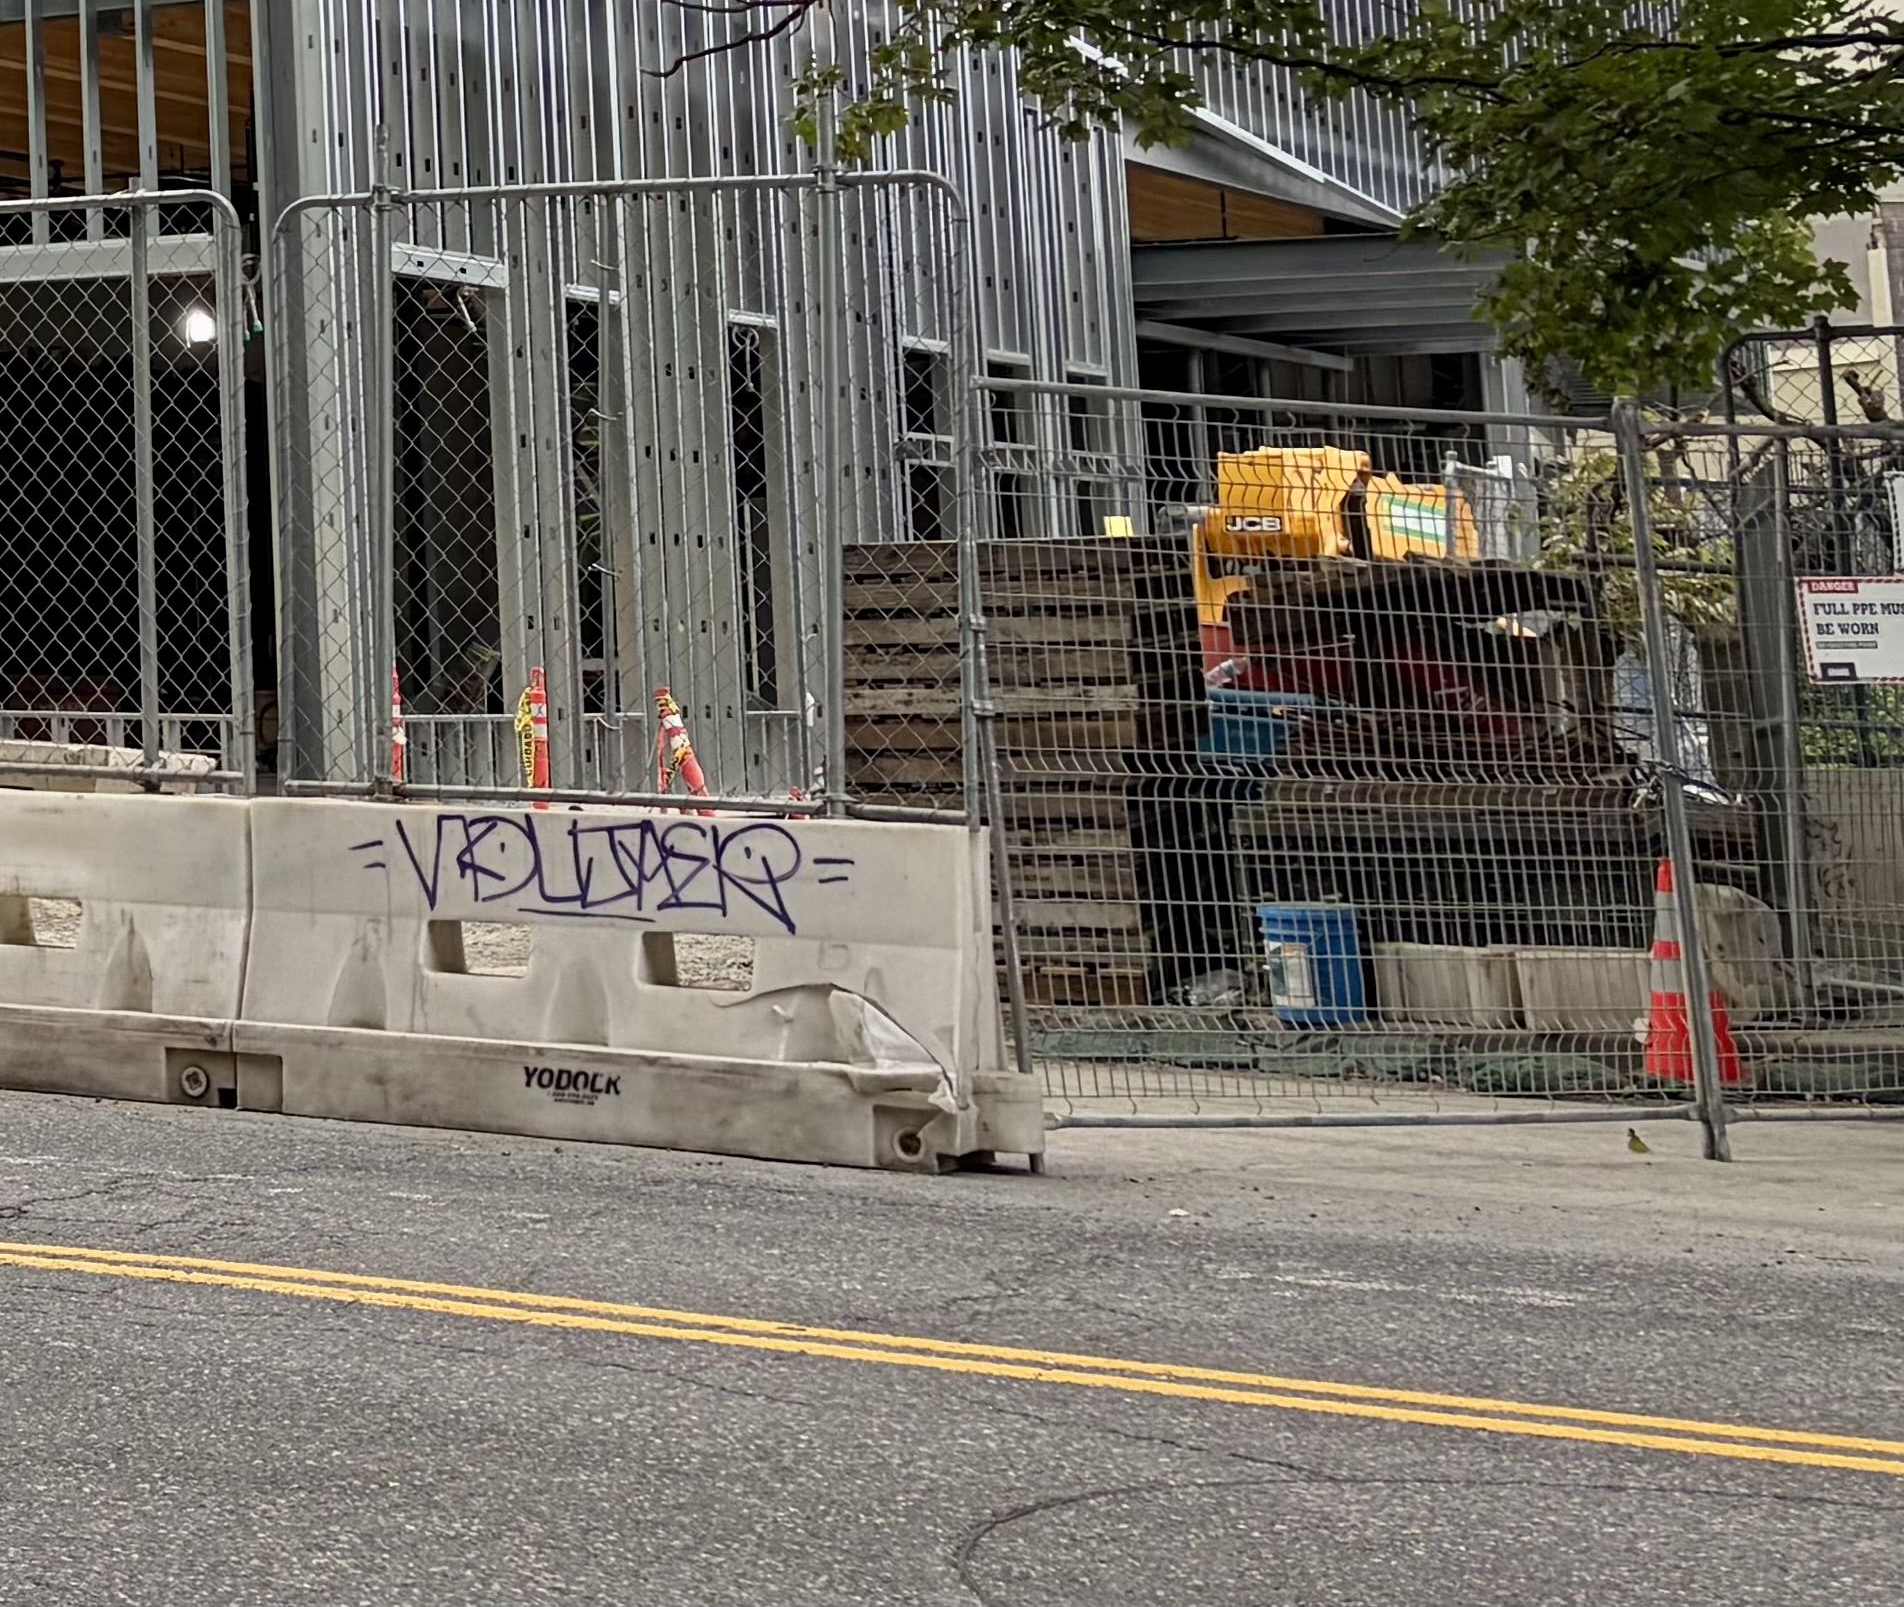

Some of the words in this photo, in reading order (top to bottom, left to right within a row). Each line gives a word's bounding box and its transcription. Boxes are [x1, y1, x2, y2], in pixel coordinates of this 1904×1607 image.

[1226, 516, 1281, 531] JCB
[1812, 581, 1856, 592] DANGER
[1813, 603, 1850, 615] FULL
[1852, 603, 1878, 615] PPE
[1816, 623, 1836, 635] BE
[1838, 623, 1880, 635] WORN
[523, 1065, 621, 1096] YODOCK
